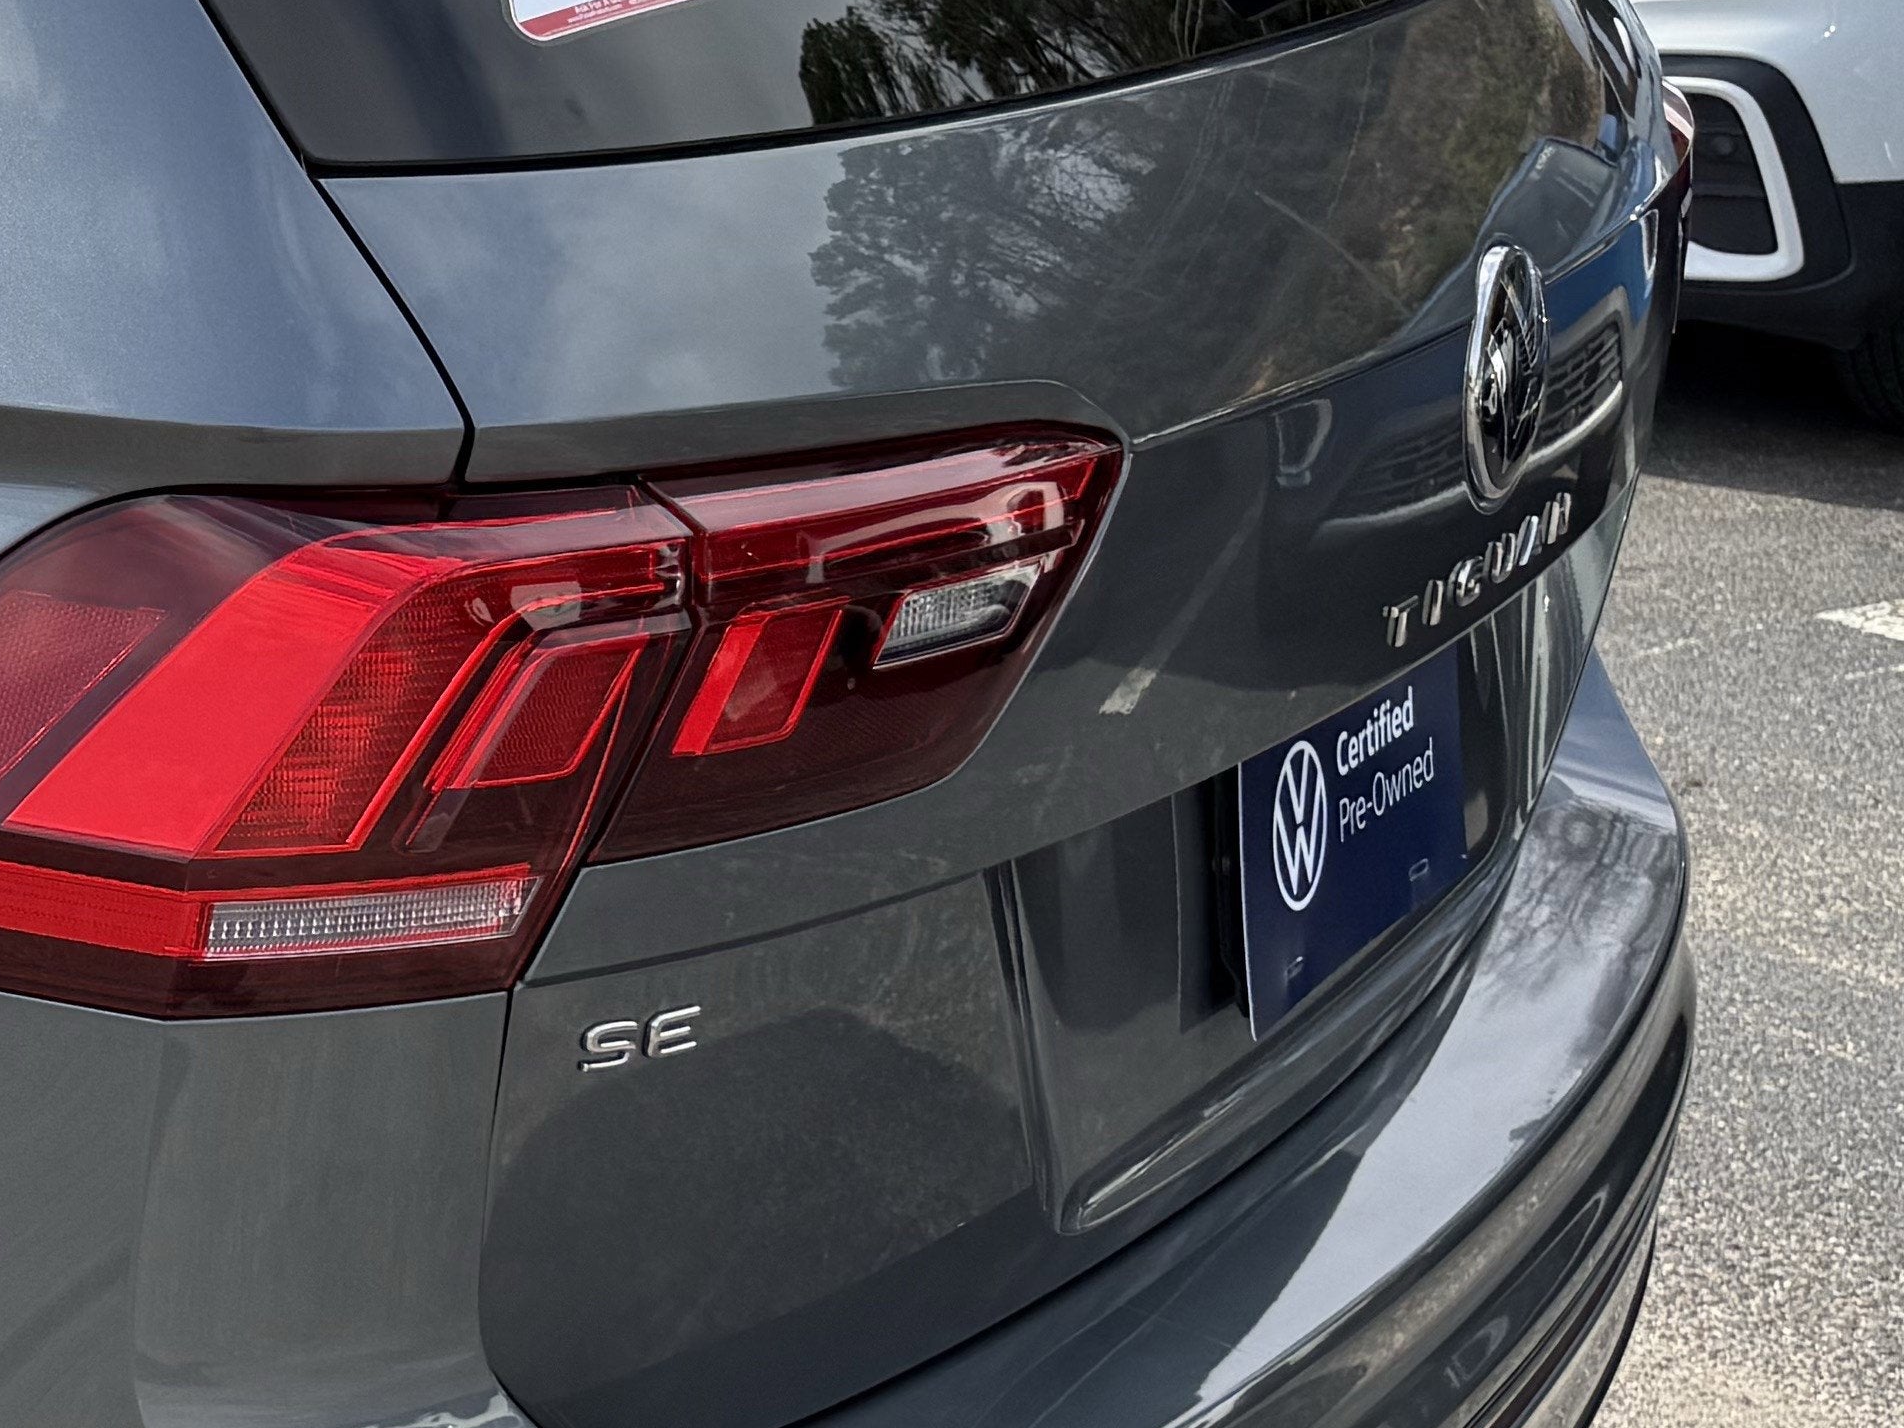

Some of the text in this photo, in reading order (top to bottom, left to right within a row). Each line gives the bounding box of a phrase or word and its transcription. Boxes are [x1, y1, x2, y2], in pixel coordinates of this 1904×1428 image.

[1382, 491, 1572, 648] TIGUAN
[1336, 685, 1415, 777] Certified
[1339, 736, 1435, 843] Pre-Owned
[578, 1004, 702, 1073] SE
